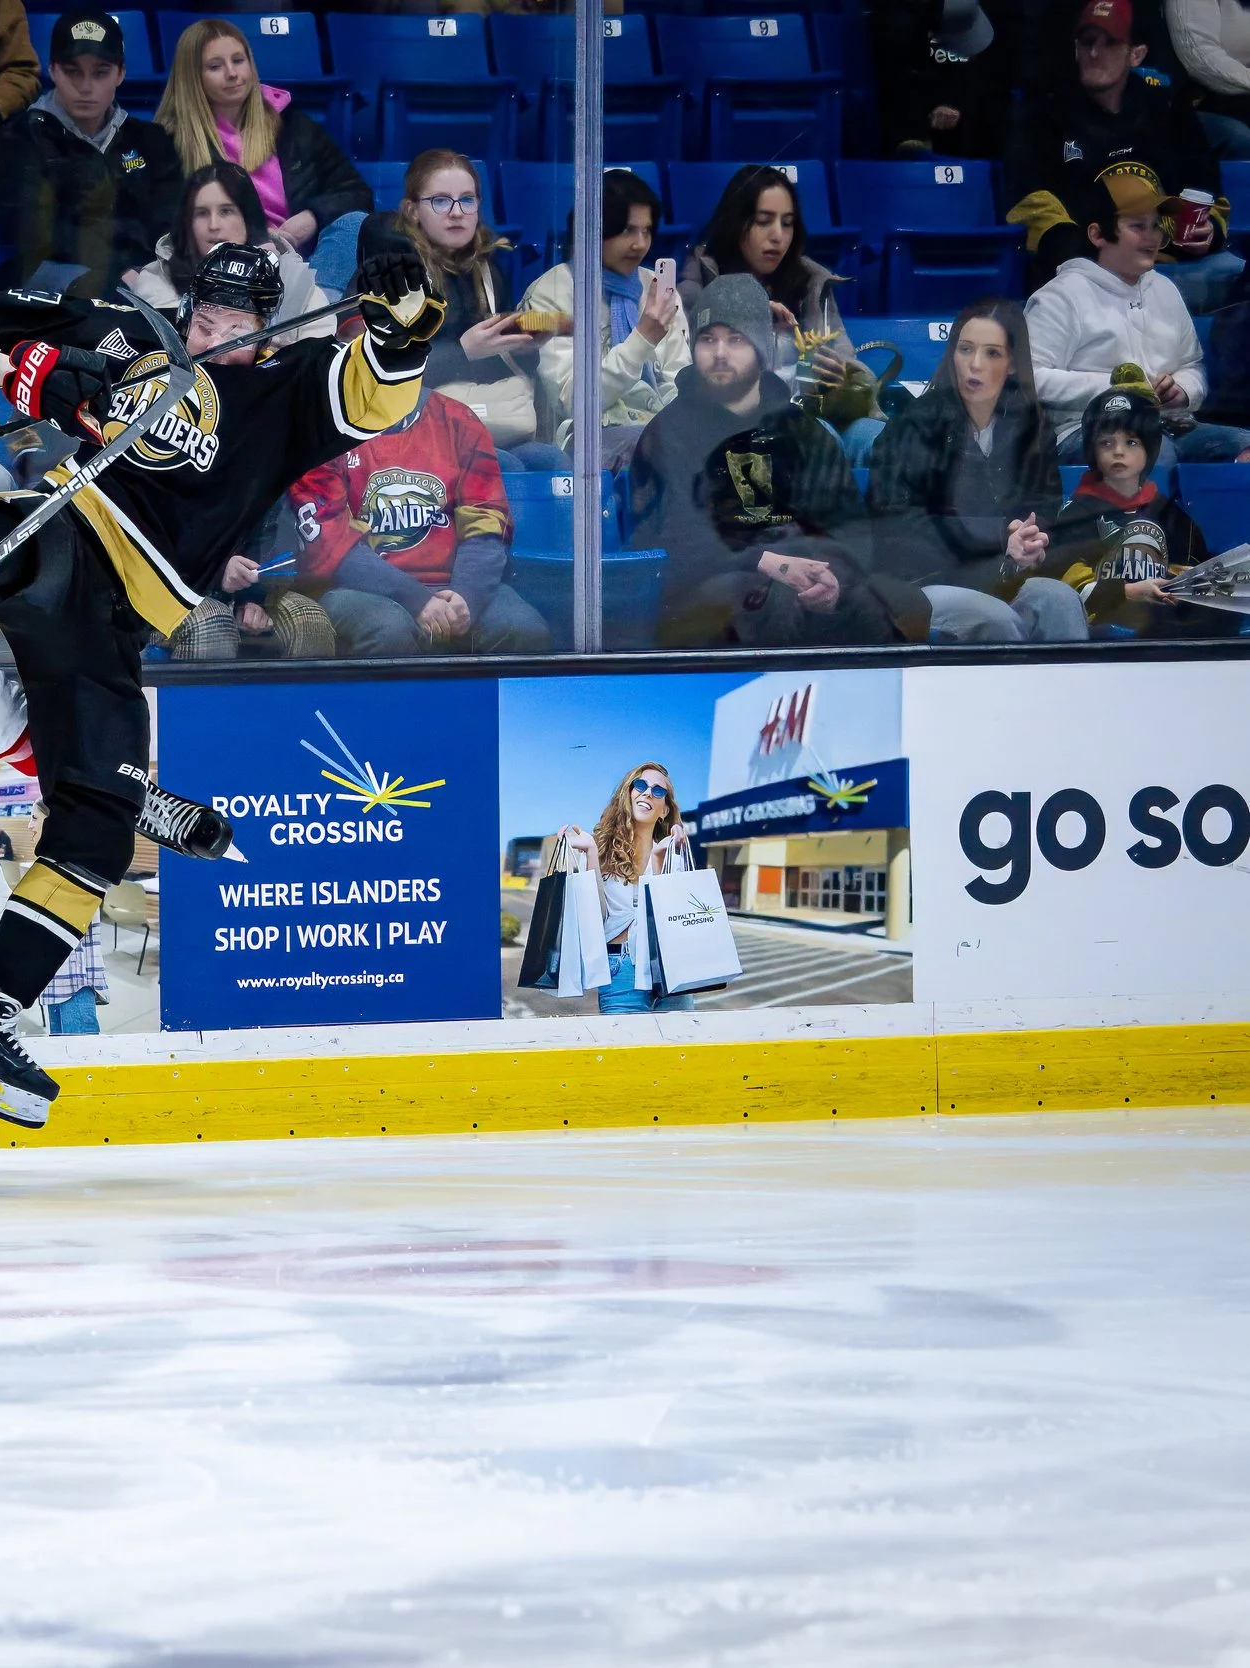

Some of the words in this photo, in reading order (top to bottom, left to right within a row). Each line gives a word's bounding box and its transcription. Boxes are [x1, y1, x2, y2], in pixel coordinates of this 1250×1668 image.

[269, 19, 280, 34] 6
[436, 20, 447, 35] 7
[604, 21, 614, 36] 8
[759, 20, 770, 36] 9
[945, 167, 955, 183] 9
[938, 323, 949, 341] 8
[16, 341, 56, 416] BAUER
[562, 477, 572, 495] 3
[759, 683, 814, 755] H&M
[212, 793, 331, 819] ROYALTY
[269, 820, 404, 845] CROSSING
[959, 789, 1106, 906] go
[219, 882, 304, 908] WHERE
[311, 878, 441, 905] ISLANDERS
[668, 911, 697, 923] ROYALTY
[681, 915, 715, 928] CROSSING
[214, 926, 279, 951] SHOP
[297, 923, 369, 949] WORK
[388, 921, 448, 945] PLAY
[236, 971, 405, 990] www.royaltycrossing.ca
